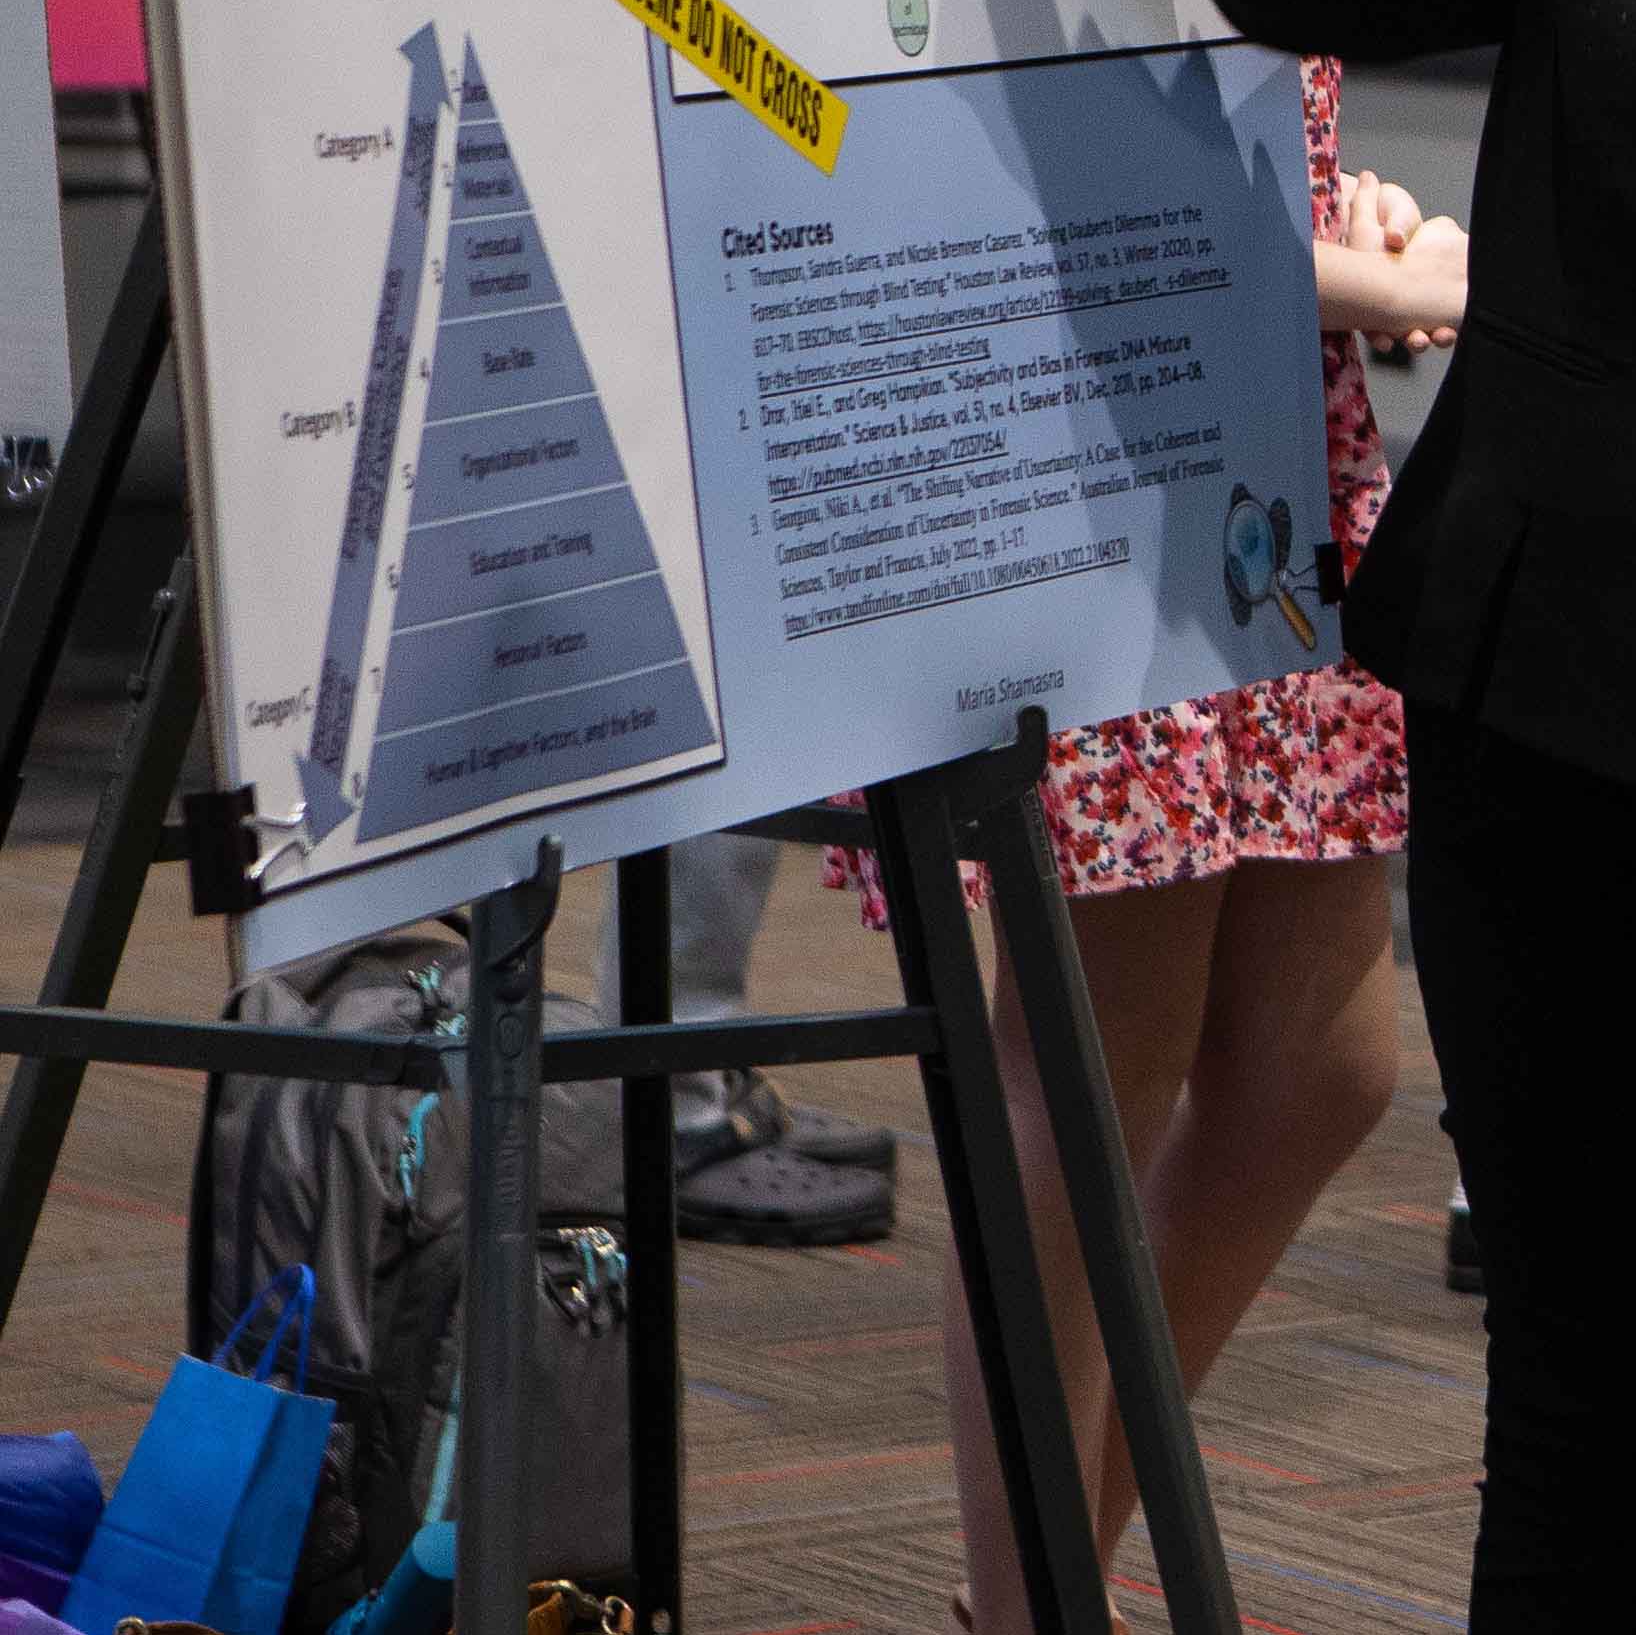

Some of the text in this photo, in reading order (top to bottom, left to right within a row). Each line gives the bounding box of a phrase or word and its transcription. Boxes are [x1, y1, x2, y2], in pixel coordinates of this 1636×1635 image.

[719, 13, 759, 94] NOT
[759, 49, 824, 148] CROSS
[1161, 208, 1178, 225] for
[1180, 204, 1201, 223] the
[722, 218, 834, 259] Cited Sources
[955, 684, 993, 712] Maria
